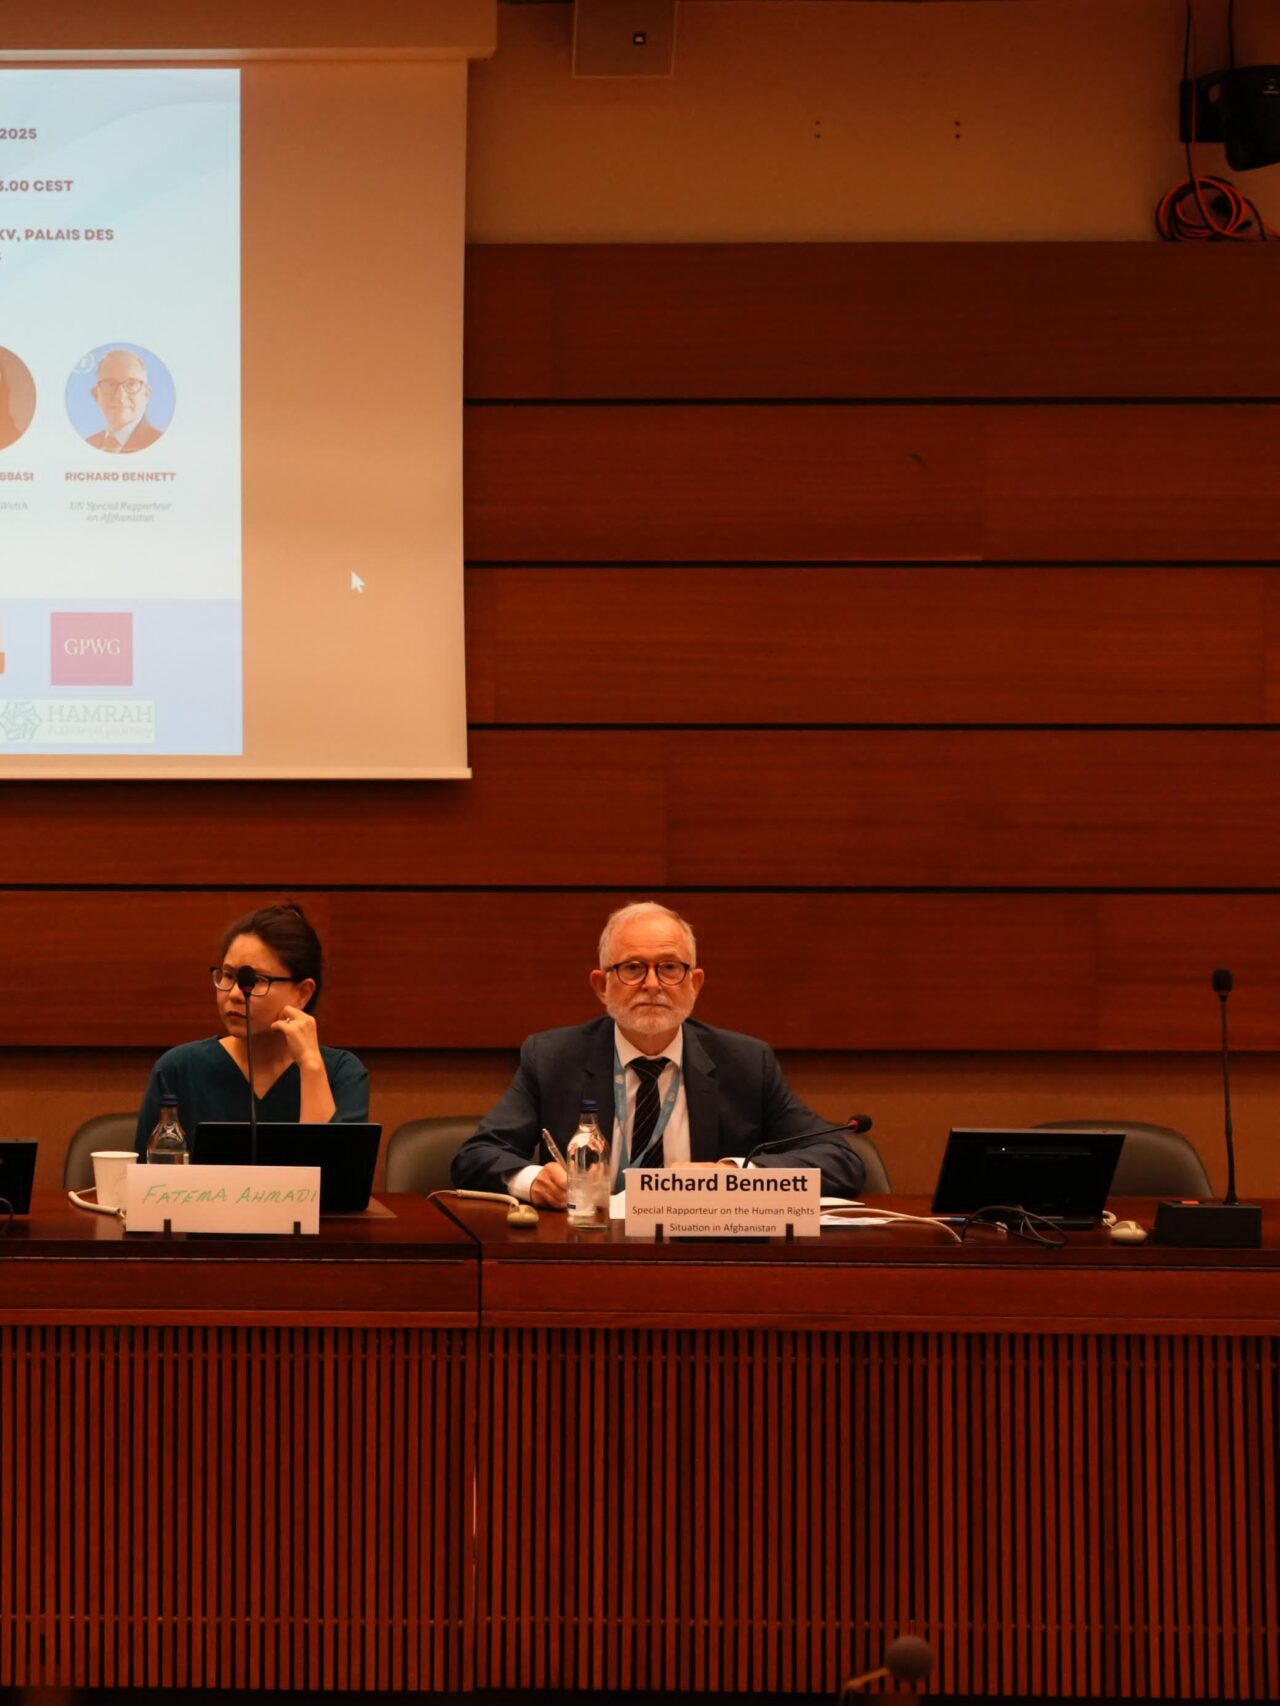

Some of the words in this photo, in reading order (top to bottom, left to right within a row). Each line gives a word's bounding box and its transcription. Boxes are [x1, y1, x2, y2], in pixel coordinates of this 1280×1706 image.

[33, 180, 74, 192] CEST
[25, 229, 80, 241] PALAIS
[85, 229, 114, 241] DES
[65, 472, 119, 481] RICHARD
[122, 472, 176, 481] BENNETT
[64, 638, 121, 656] GPWG
[47, 704, 153, 723] HAMRAH
[640, 1174, 718, 1192] Richard
[726, 1175, 808, 1192] Bennett
[142, 1184, 226, 1204] FATEMA
[235, 1186, 317, 1204] AHMADI
[632, 1206, 664, 1217] Special
[667, 1206, 717, 1217] Rapporteur
[735, 1206, 749, 1215] the
[752, 1206, 784, 1215] Human
[787, 1206, 815, 1217] Rights
[670, 1223, 710, 1232] Situation
[712, 1223, 721, 1232] in
[723, 1223, 776, 1234] Afghanistan
